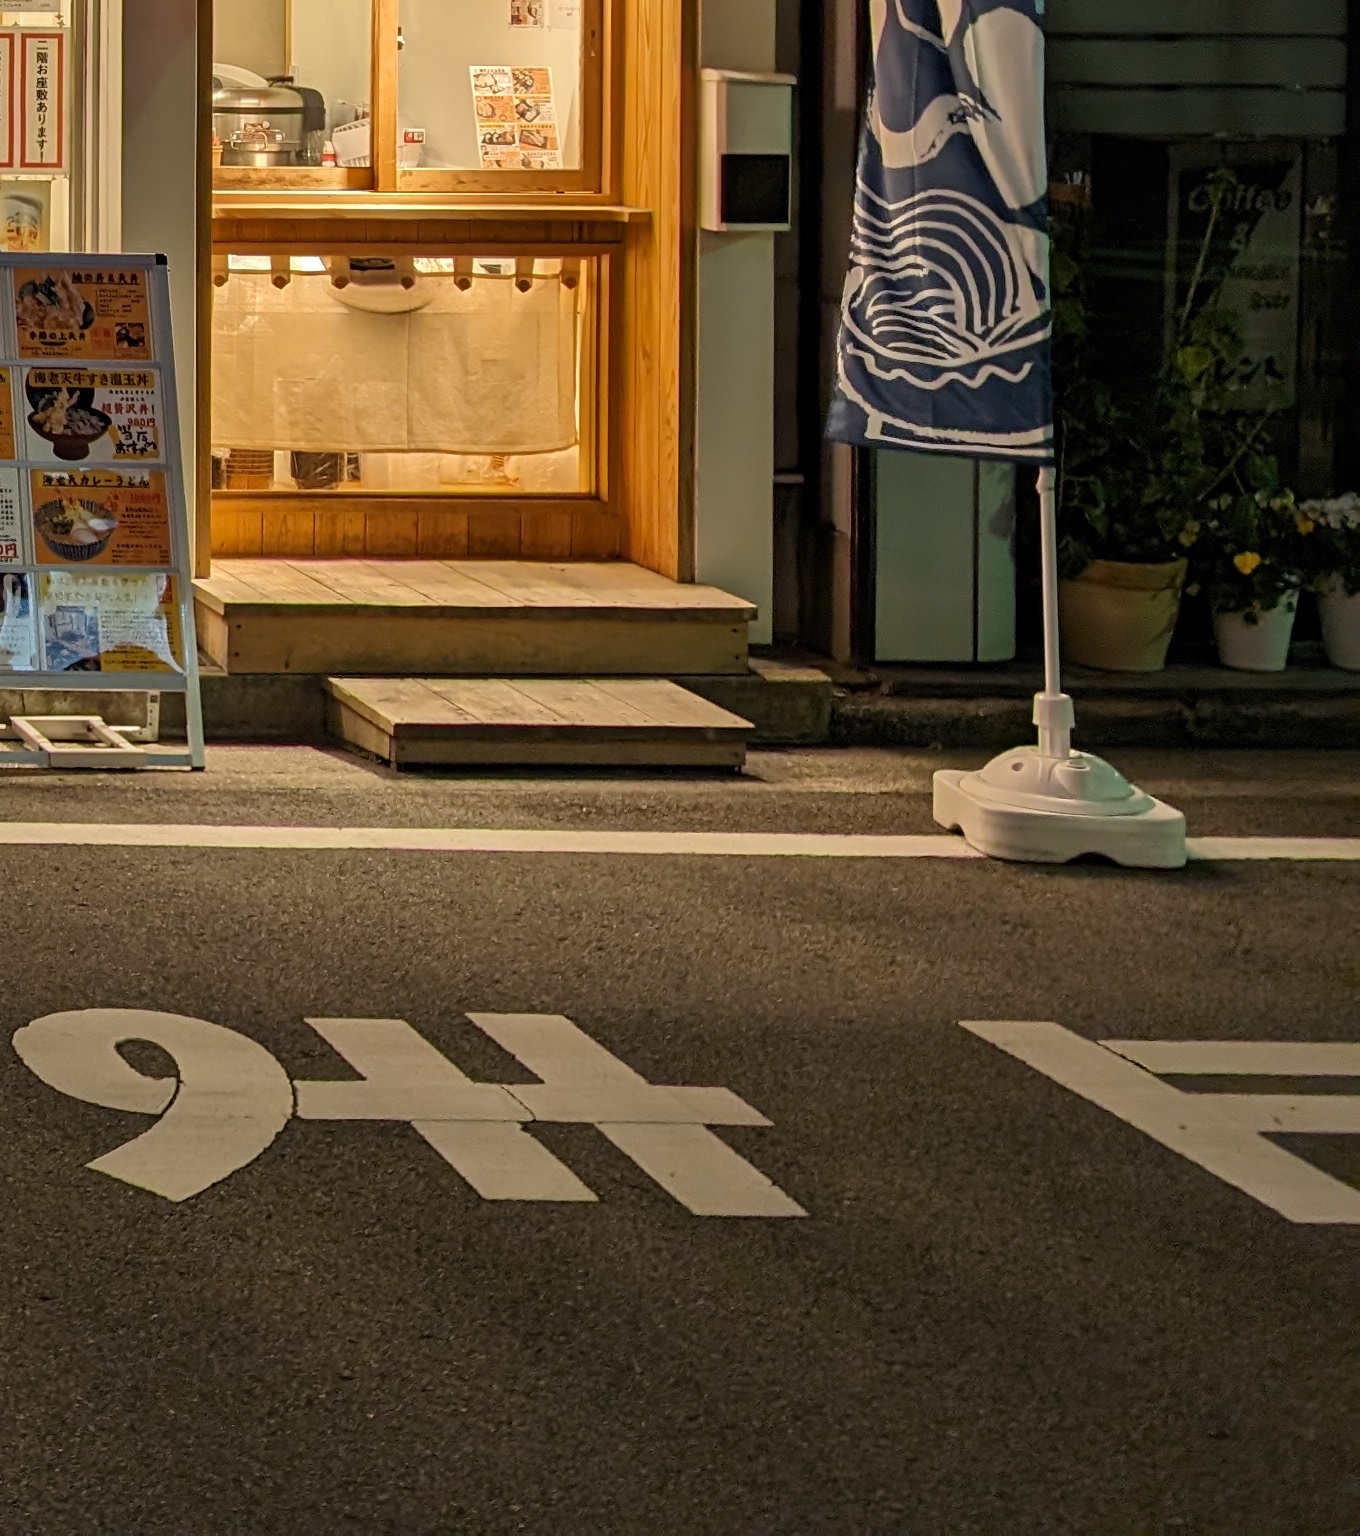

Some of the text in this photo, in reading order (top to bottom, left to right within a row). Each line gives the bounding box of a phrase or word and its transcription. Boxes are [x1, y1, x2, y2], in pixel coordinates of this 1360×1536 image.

[35, 40, 49, 163] 二階お座敷あります！
[34, 371, 149, 387] 海老天牛すき温玉丼
[127, 417, 156, 427] 980円
